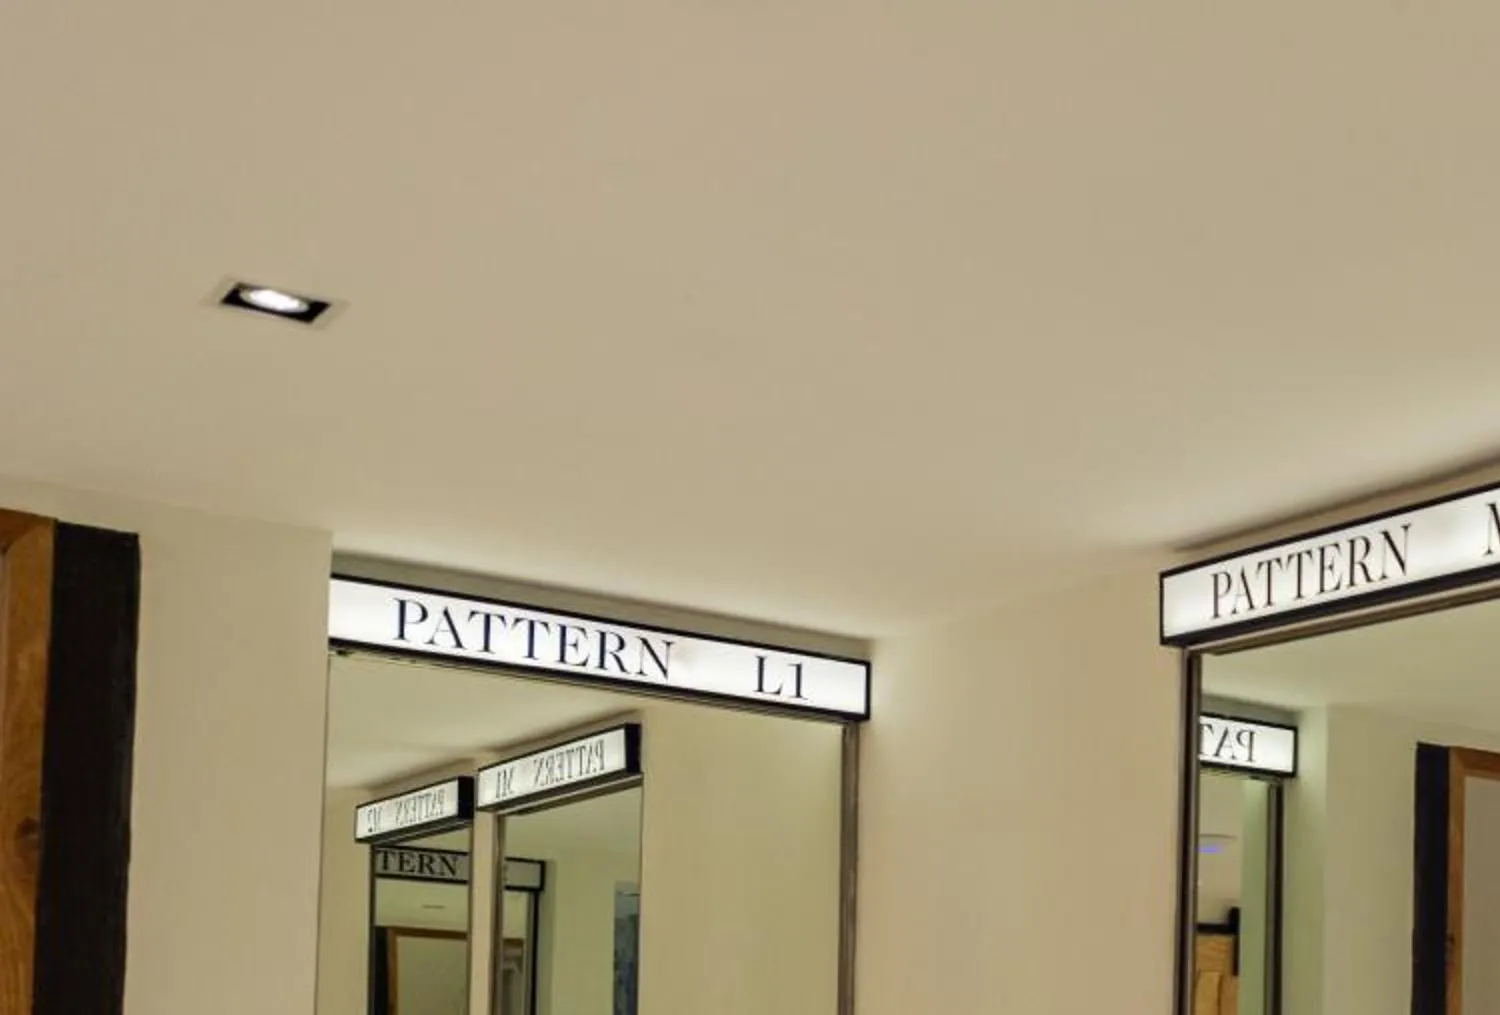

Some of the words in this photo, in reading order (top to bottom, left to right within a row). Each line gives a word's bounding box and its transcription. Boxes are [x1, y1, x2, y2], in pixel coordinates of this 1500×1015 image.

[1210, 522, 1412, 620] PATTERN
[392, 597, 677, 681] PATTERN
[754, 655, 809, 701] L1
